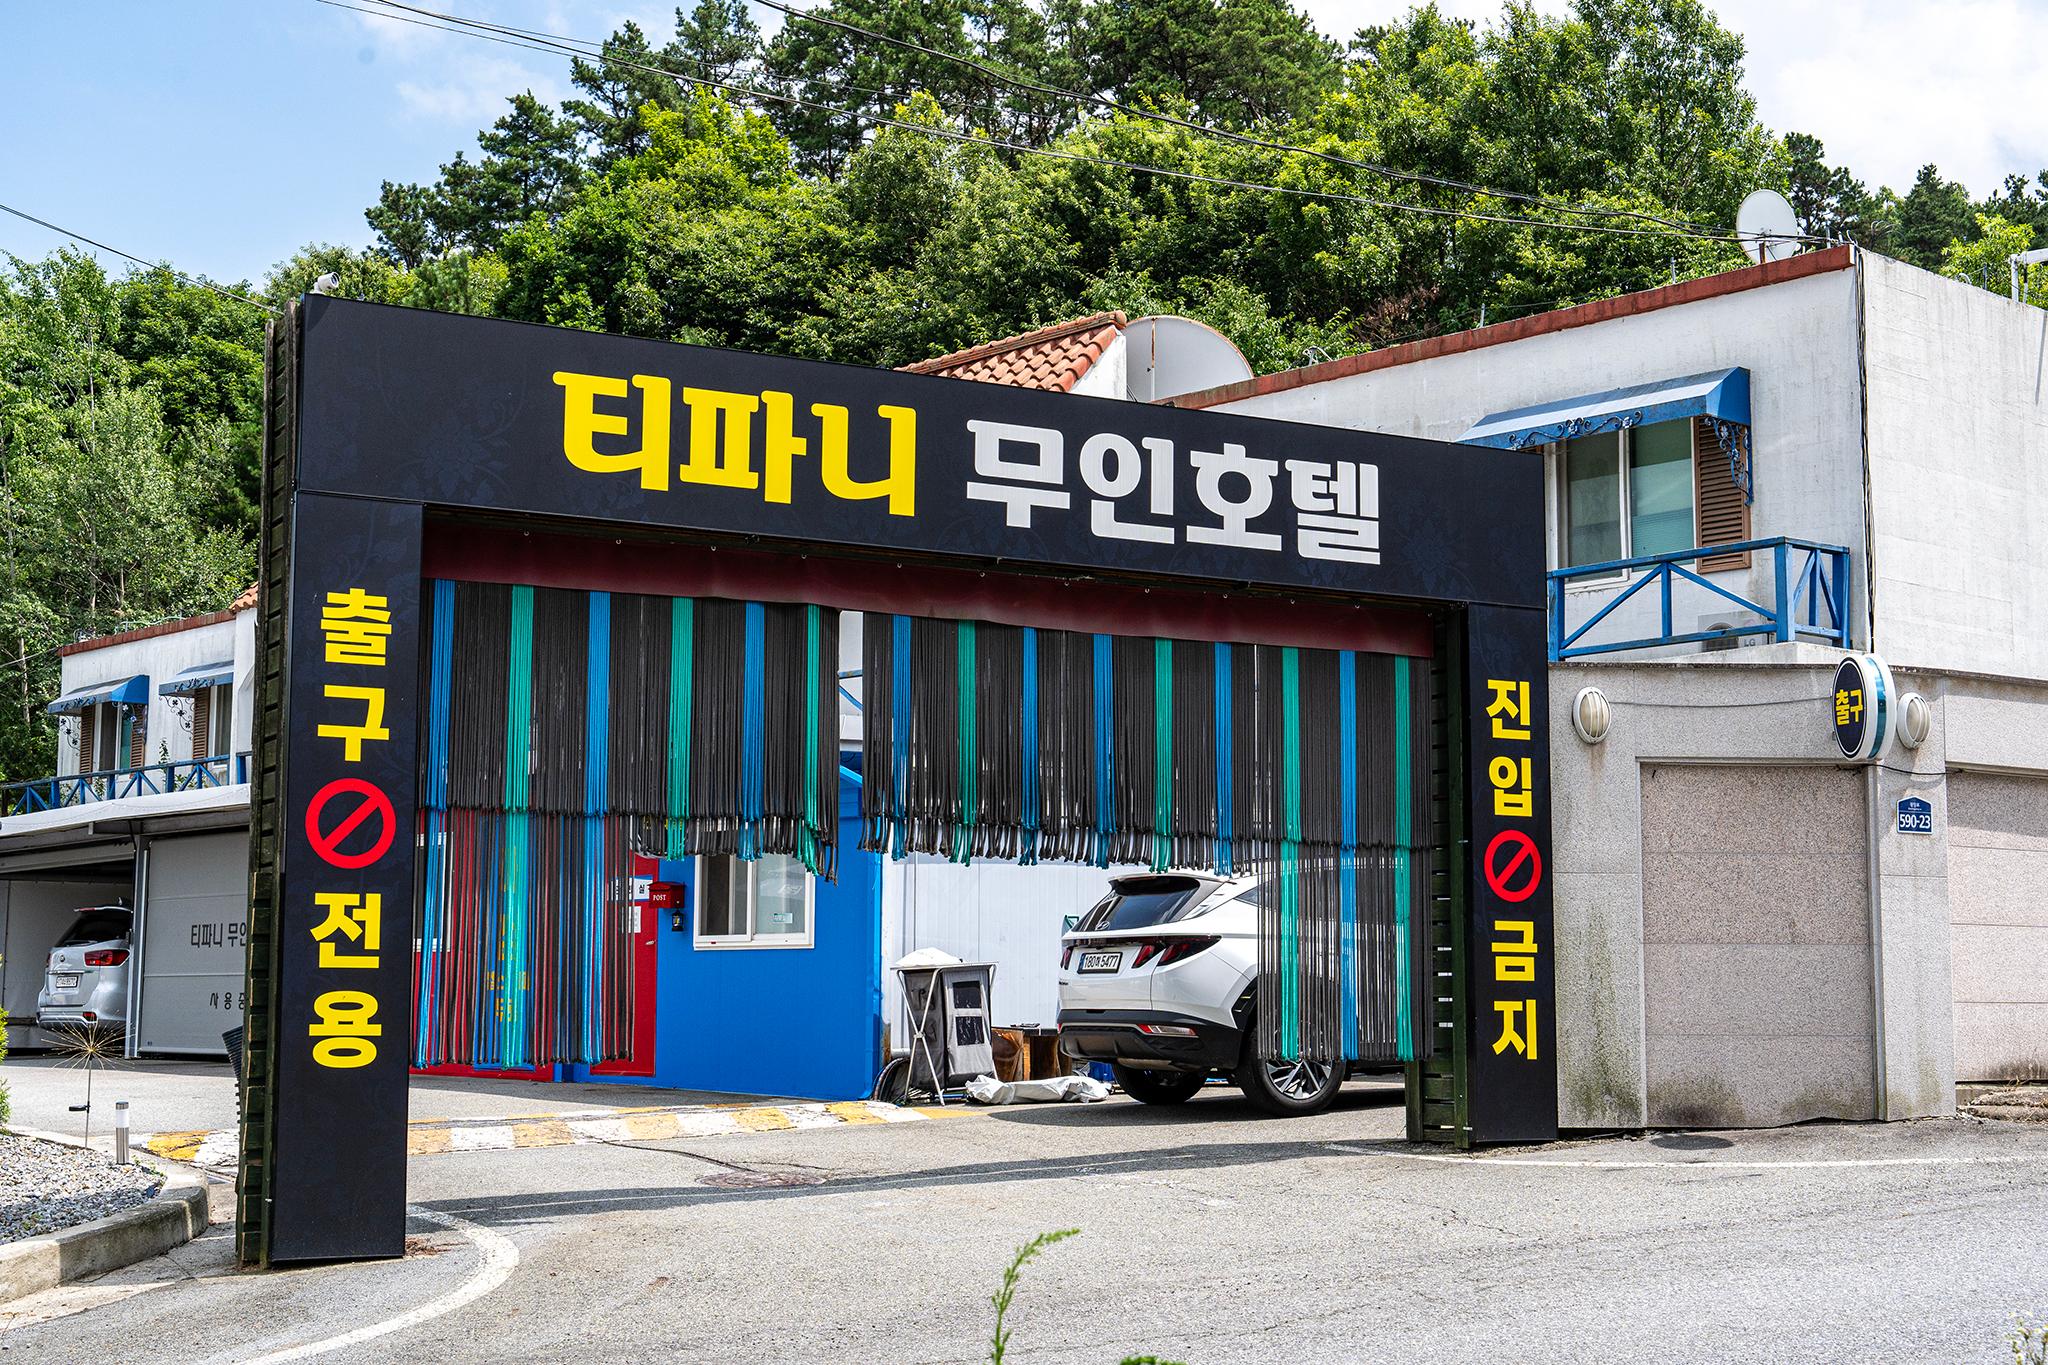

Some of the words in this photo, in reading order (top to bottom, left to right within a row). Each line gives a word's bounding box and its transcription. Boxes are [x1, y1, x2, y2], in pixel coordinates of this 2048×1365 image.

[552, 371, 917, 517] 티파니
[966, 419, 1380, 565] 무인호텔
[317, 587, 392, 762] 출구
[1743, 638, 1756, 647] LG
[1835, 689, 1863, 726] 출구
[1486, 679, 1533, 817] 진입
[1899, 813, 1931, 828] 590-23
[190, 923, 224, 948] 티파니
[309, 892, 382, 1069] 전용
[1491, 920, 1538, 1060] 금지
